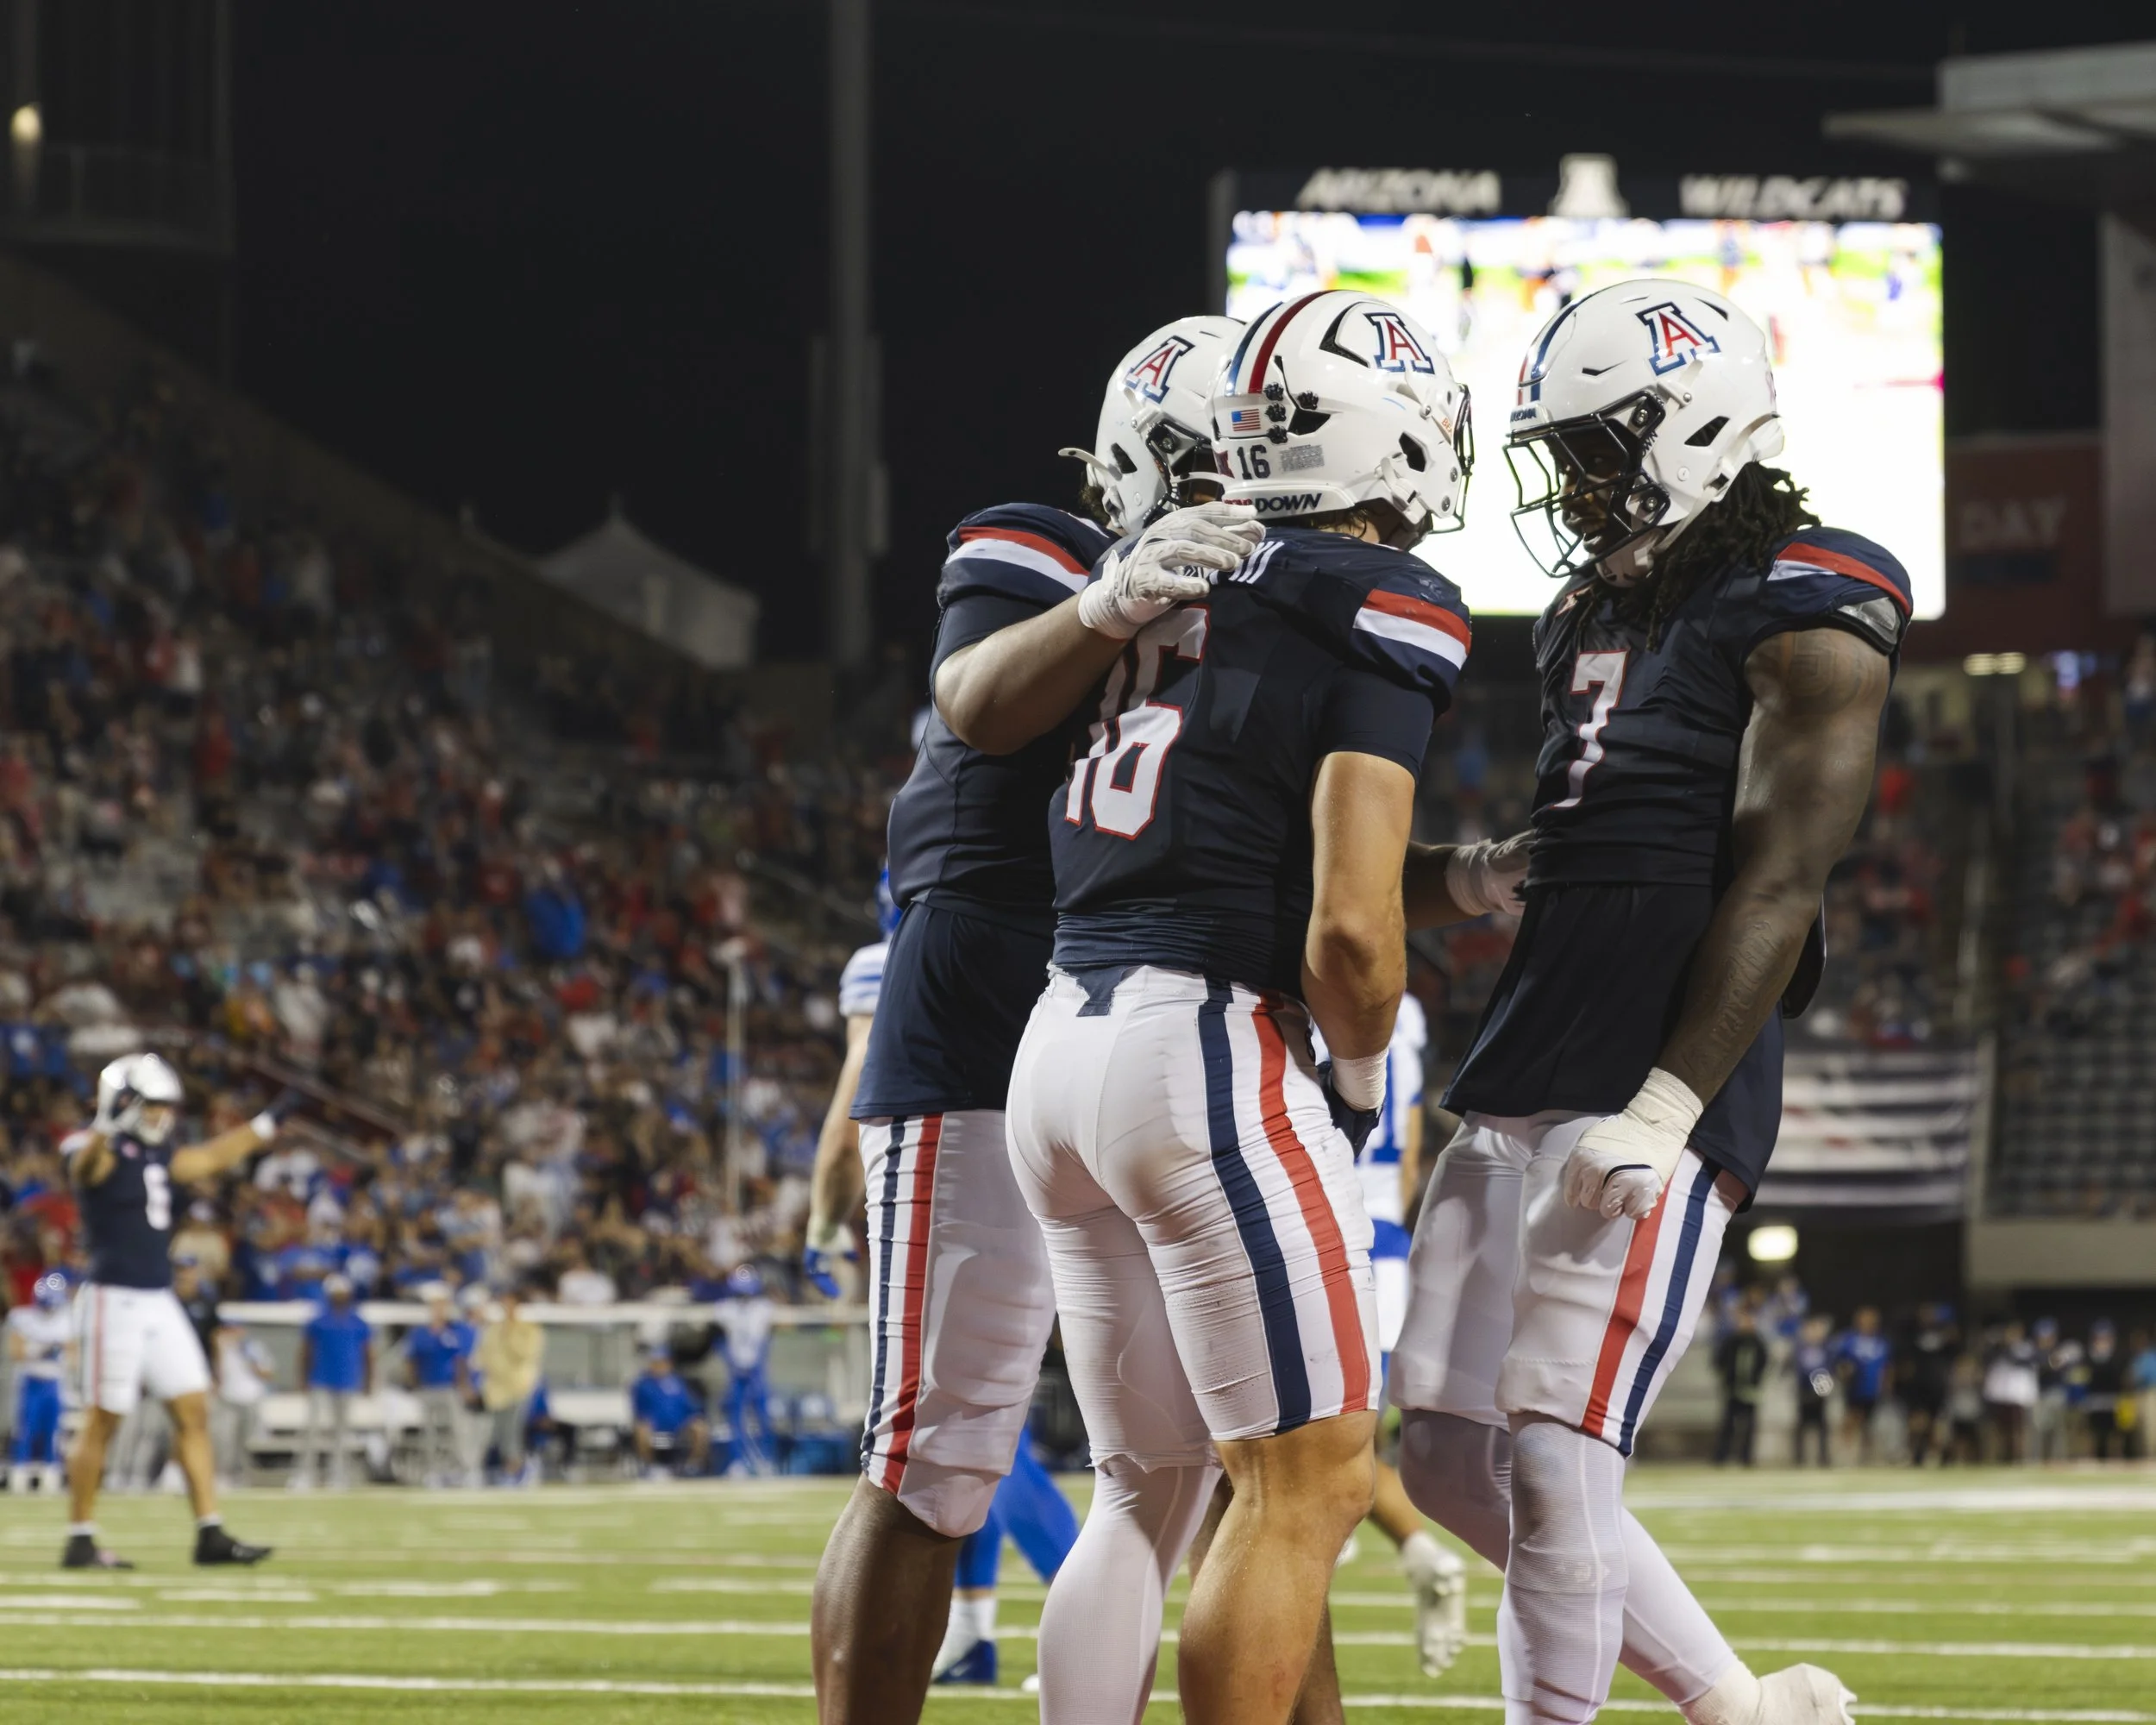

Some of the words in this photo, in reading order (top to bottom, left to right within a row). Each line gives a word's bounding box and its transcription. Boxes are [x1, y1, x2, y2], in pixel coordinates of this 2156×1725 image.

[1295, 168, 1501, 213] ARIZONA
[1680, 174, 1908, 219] WILDCATS
[1124, 335, 1195, 404] A
[1363, 312, 1435, 374] A
[1635, 301, 1721, 375] A
[1237, 444, 1270, 480] 16
[1254, 493, 1322, 512] DOWN
[1064, 604, 1210, 842] 16
[1551, 649, 1631, 807] 7
